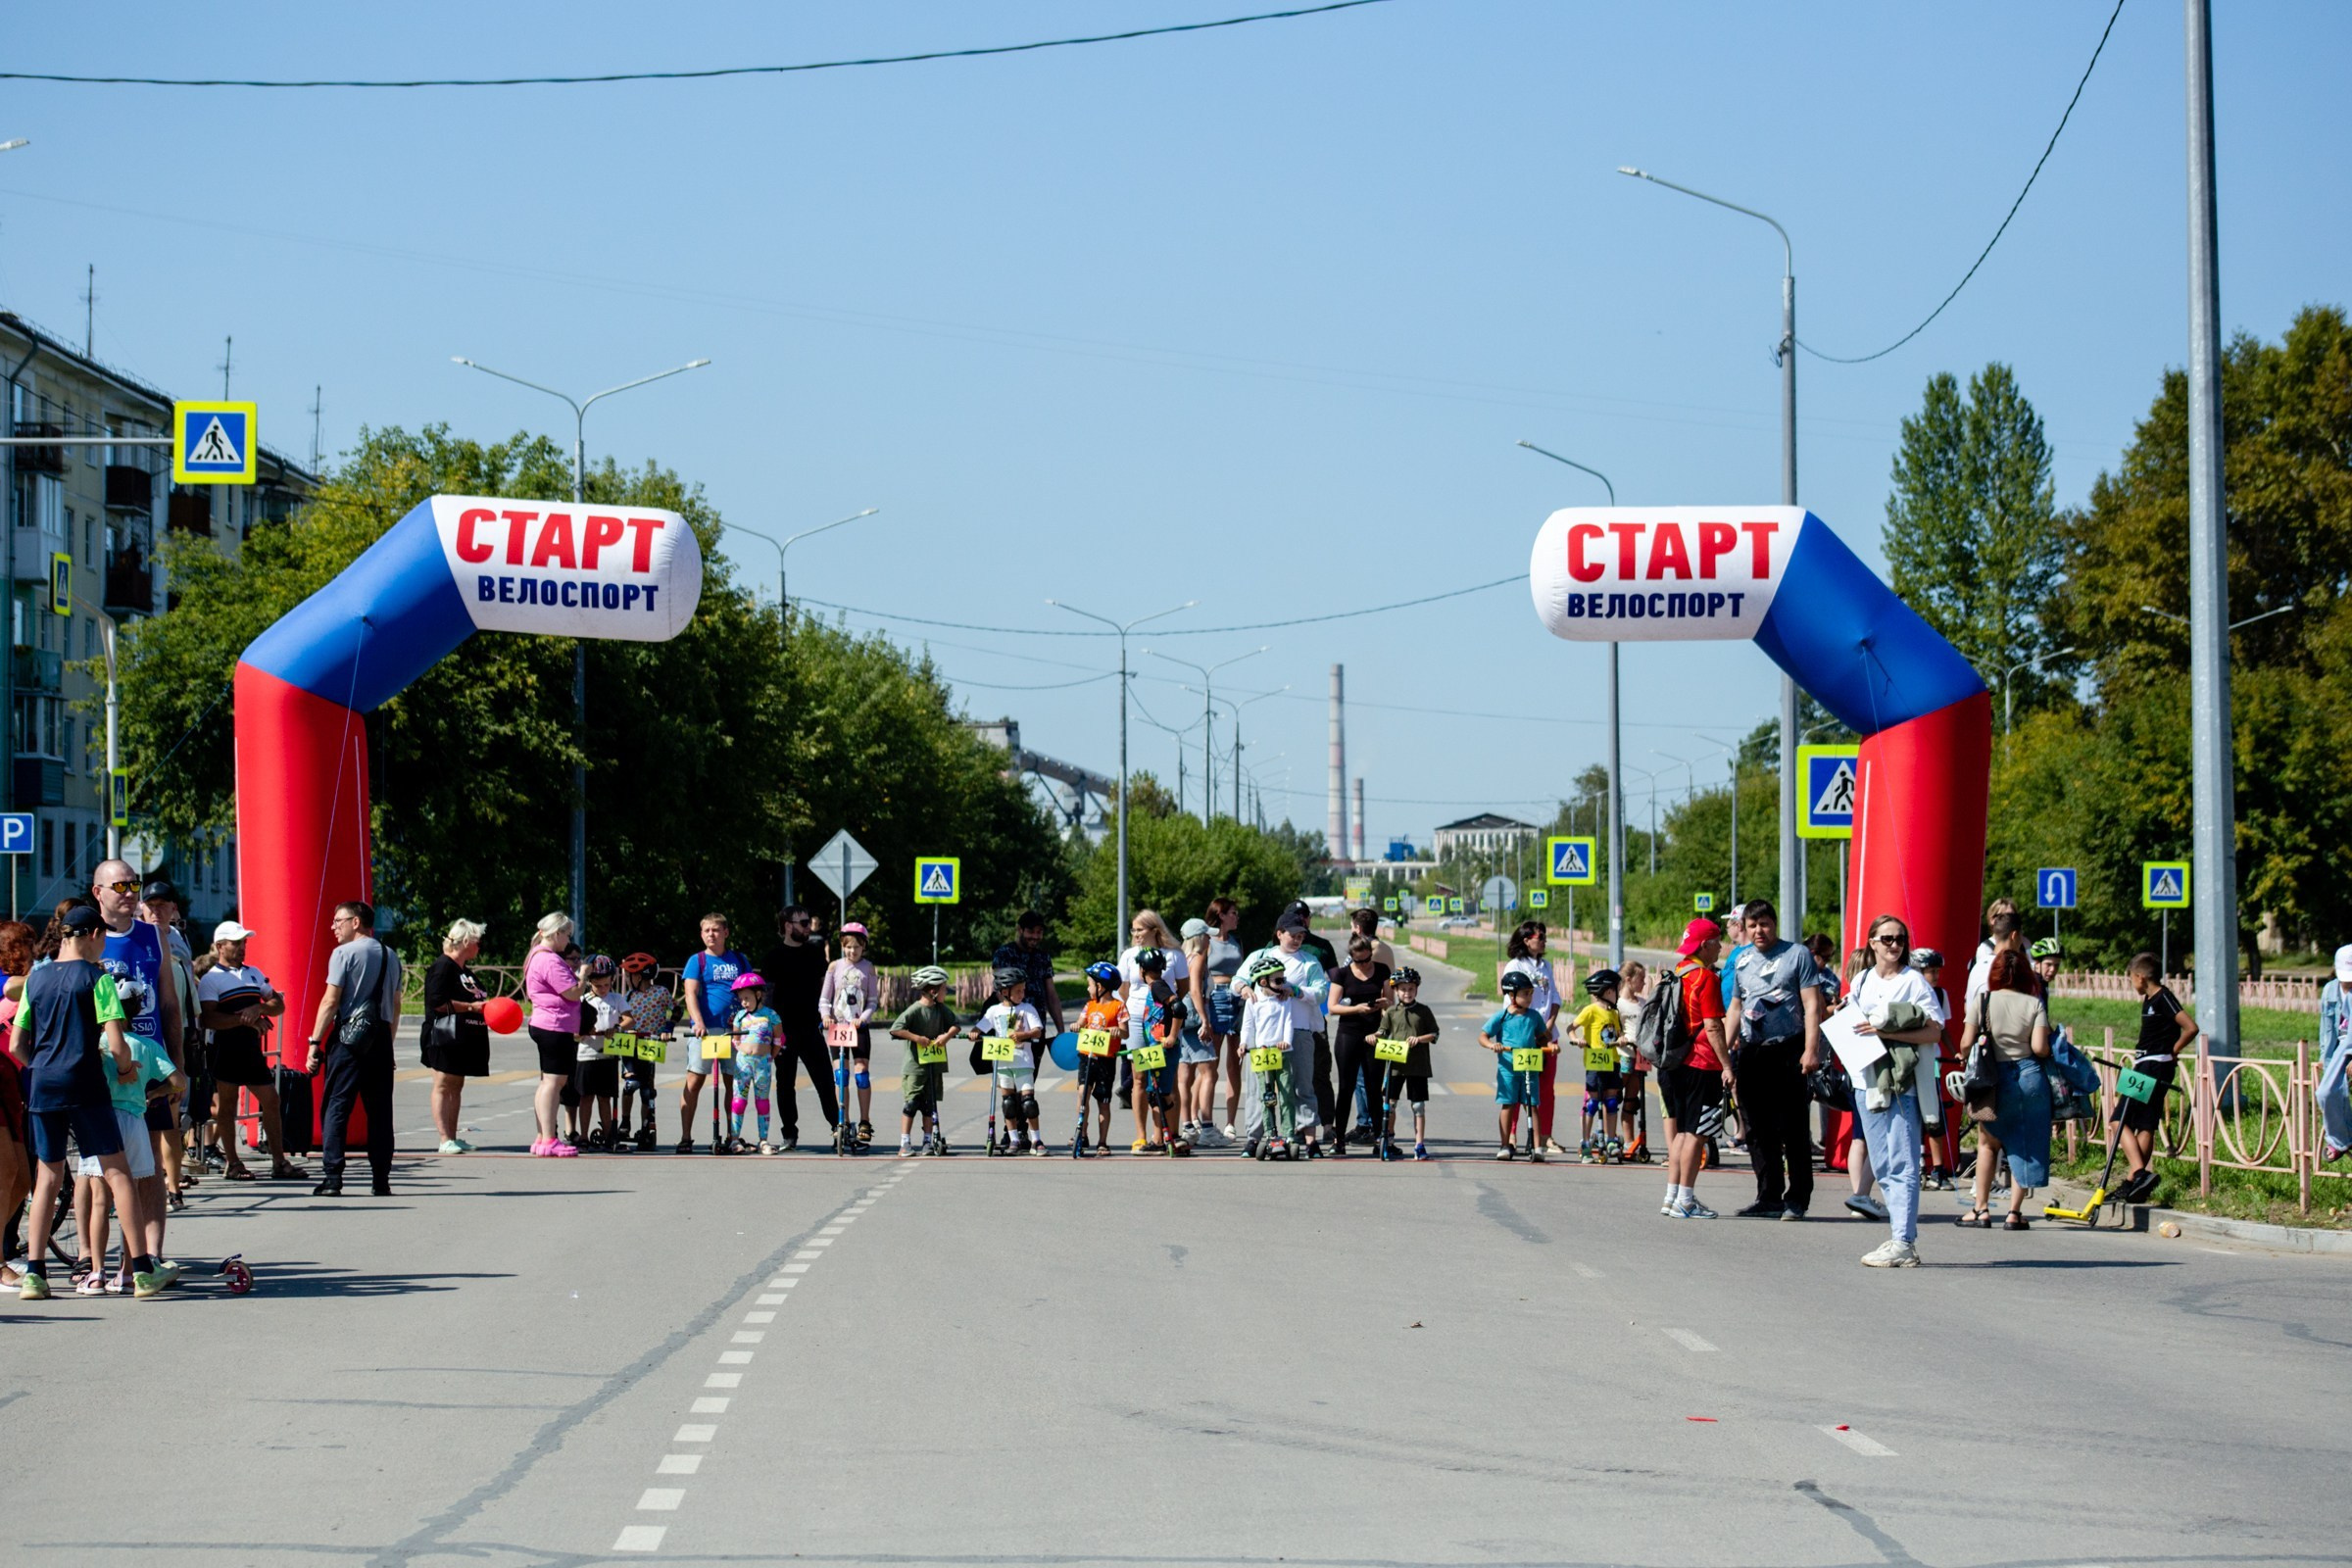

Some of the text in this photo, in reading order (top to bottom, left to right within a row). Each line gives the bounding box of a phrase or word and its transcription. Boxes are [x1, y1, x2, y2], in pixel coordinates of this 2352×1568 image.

[456, 509, 665, 573] СТАРТ
[1567, 522, 1779, 583] СТАРТ
[477, 575, 659, 612] ВЕЛОСПОРТ
[1567, 592, 1744, 618] ВЕЛОСПОРТ
[4, 818, 24, 849] P
[712, 963, 738, 973] 2018
[131, 1022, 154, 1032] SSIA
[833, 1030, 853, 1042] 181
[1082, 1033, 1105, 1048] 248
[608, 1038, 630, 1051] 244
[713, 1042, 717, 1054] 1
[987, 1044, 1009, 1055] 245
[1380, 1042, 1403, 1055] 252
[642, 1045, 661, 1058] 251
[922, 1046, 943, 1057] 246
[1138, 1051, 1160, 1065] 242
[1254, 1054, 1278, 1066] 243
[1517, 1054, 1539, 1065] 247
[1591, 1053, 1610, 1064] 250
[2127, 1075, 2145, 1093] 94
